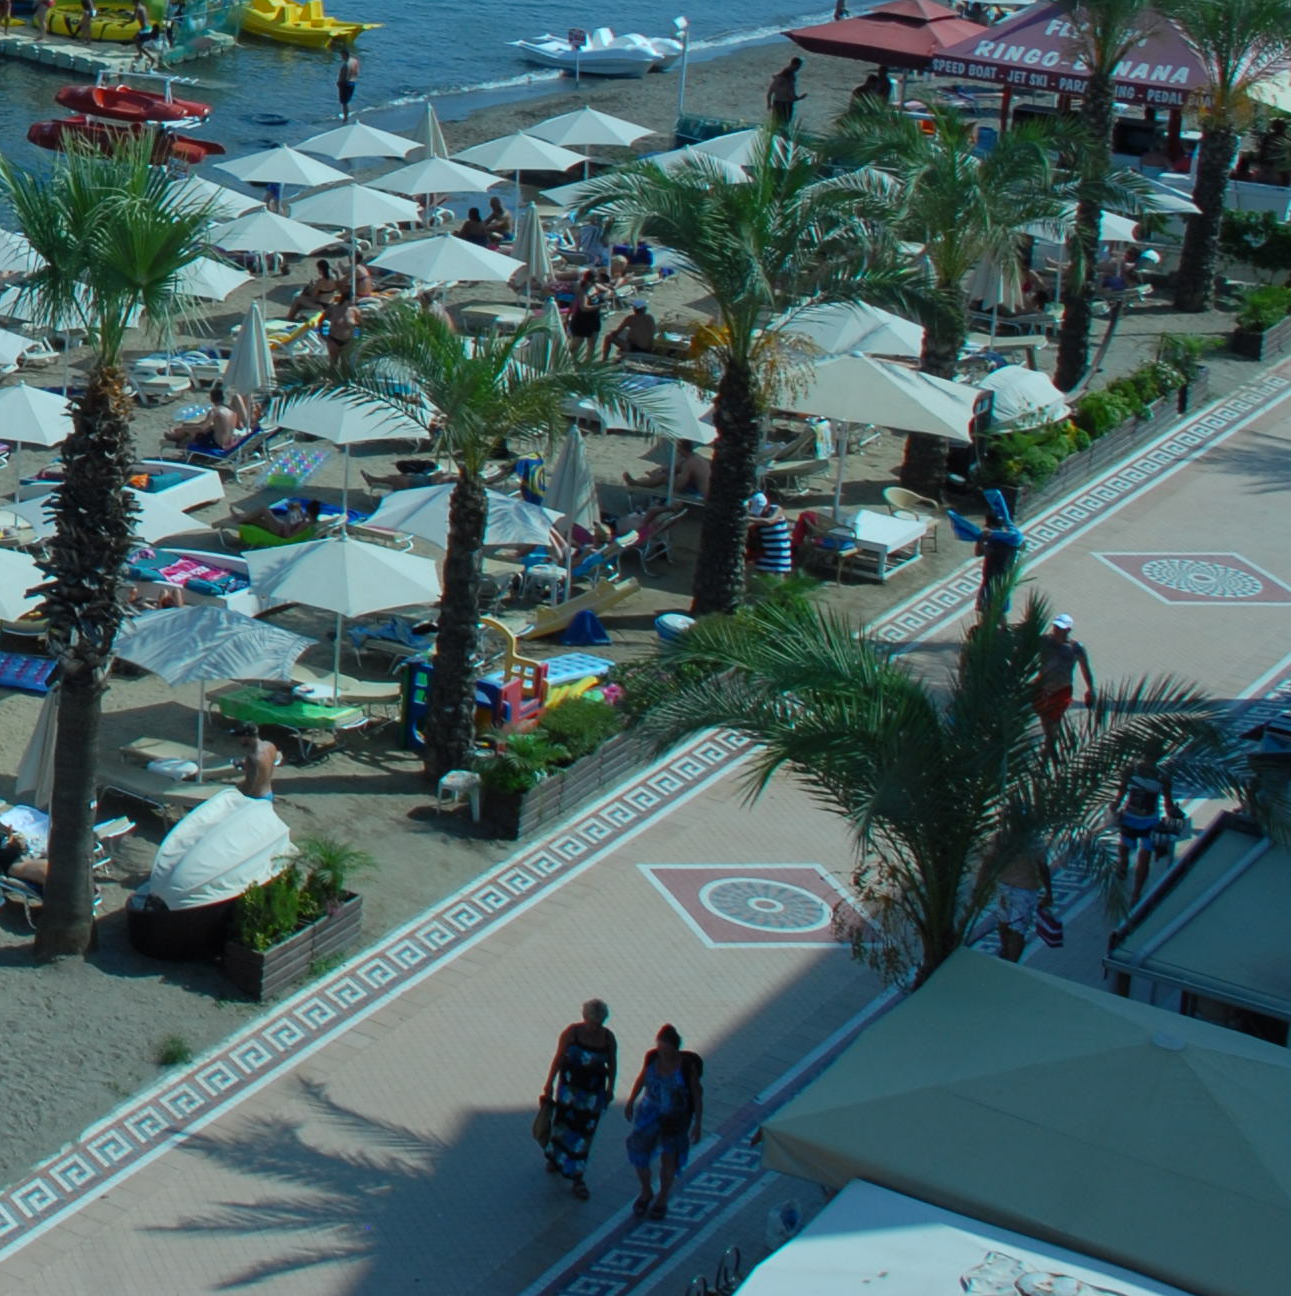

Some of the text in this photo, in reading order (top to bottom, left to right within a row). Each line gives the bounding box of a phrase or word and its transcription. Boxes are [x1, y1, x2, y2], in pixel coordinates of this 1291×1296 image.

[932, 58, 965, 75] SPEED
[968, 64, 997, 80] BOAT
[1007, 70, 1027, 83] JET
[1030, 73, 1048, 87] SKI
[1147, 89, 1184, 105] PEDAL
